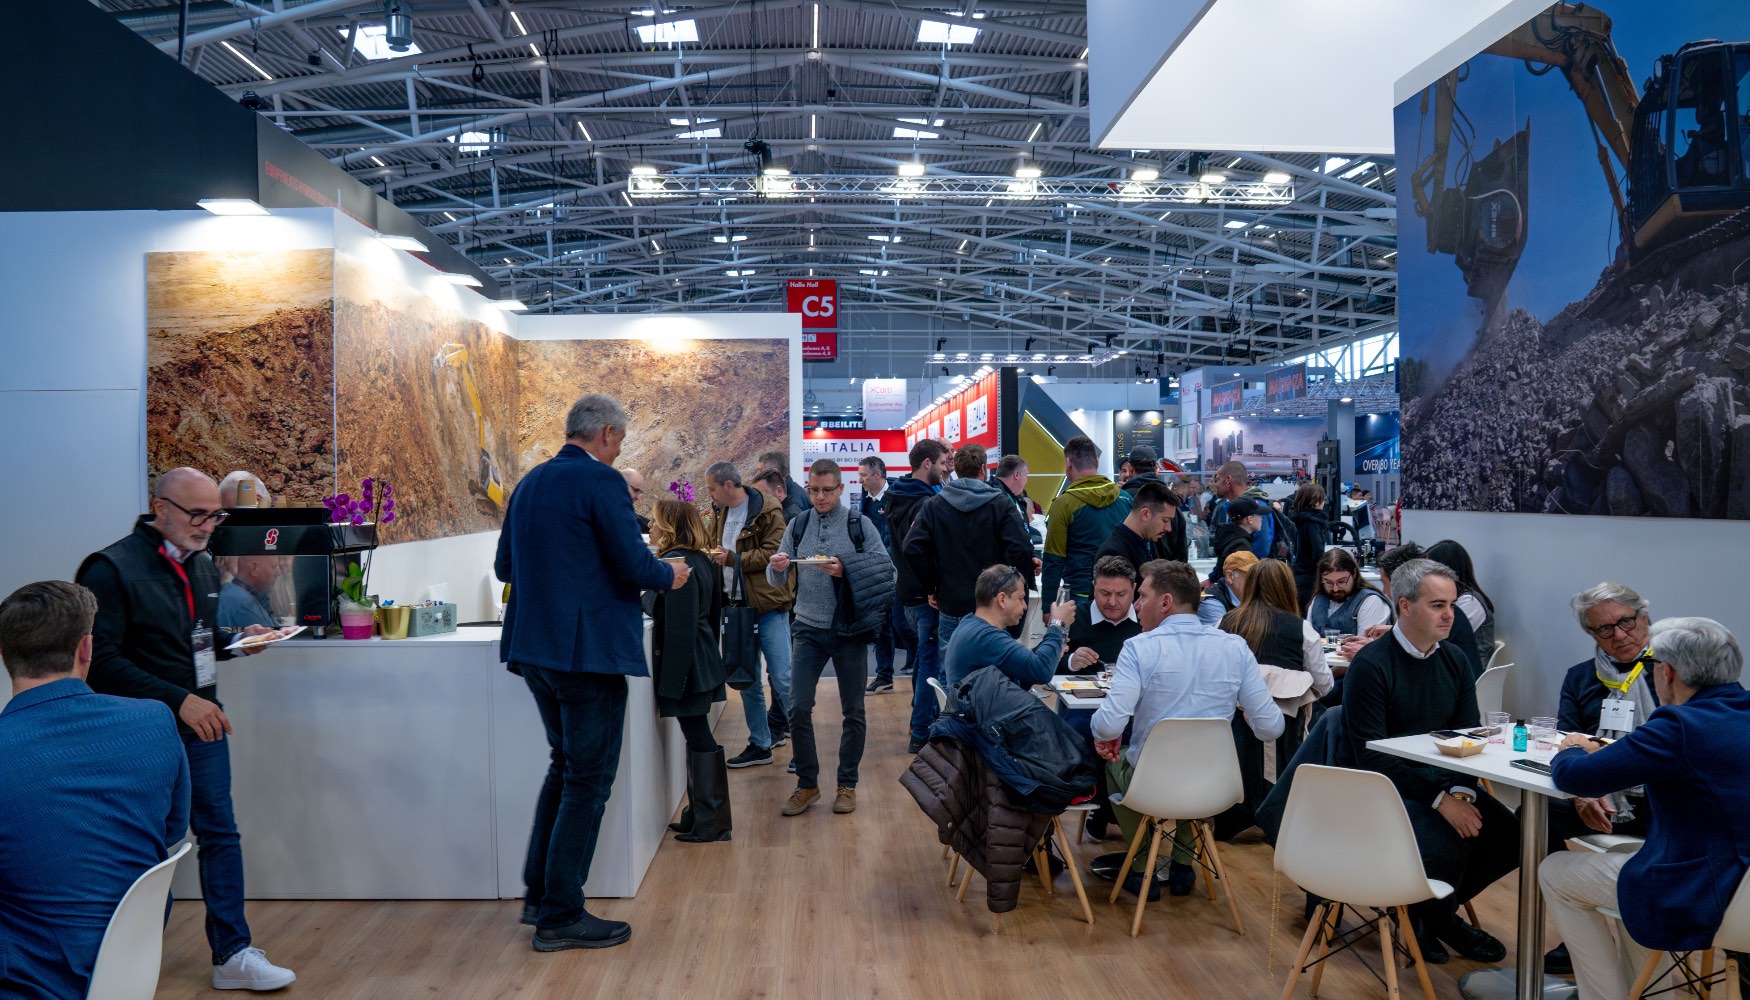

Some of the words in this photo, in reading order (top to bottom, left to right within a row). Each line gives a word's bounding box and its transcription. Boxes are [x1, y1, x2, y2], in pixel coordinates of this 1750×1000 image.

[802, 295, 834, 317] C5
[824, 443, 875, 452] ITALIA
[1362, 459, 1379, 471] OVER
